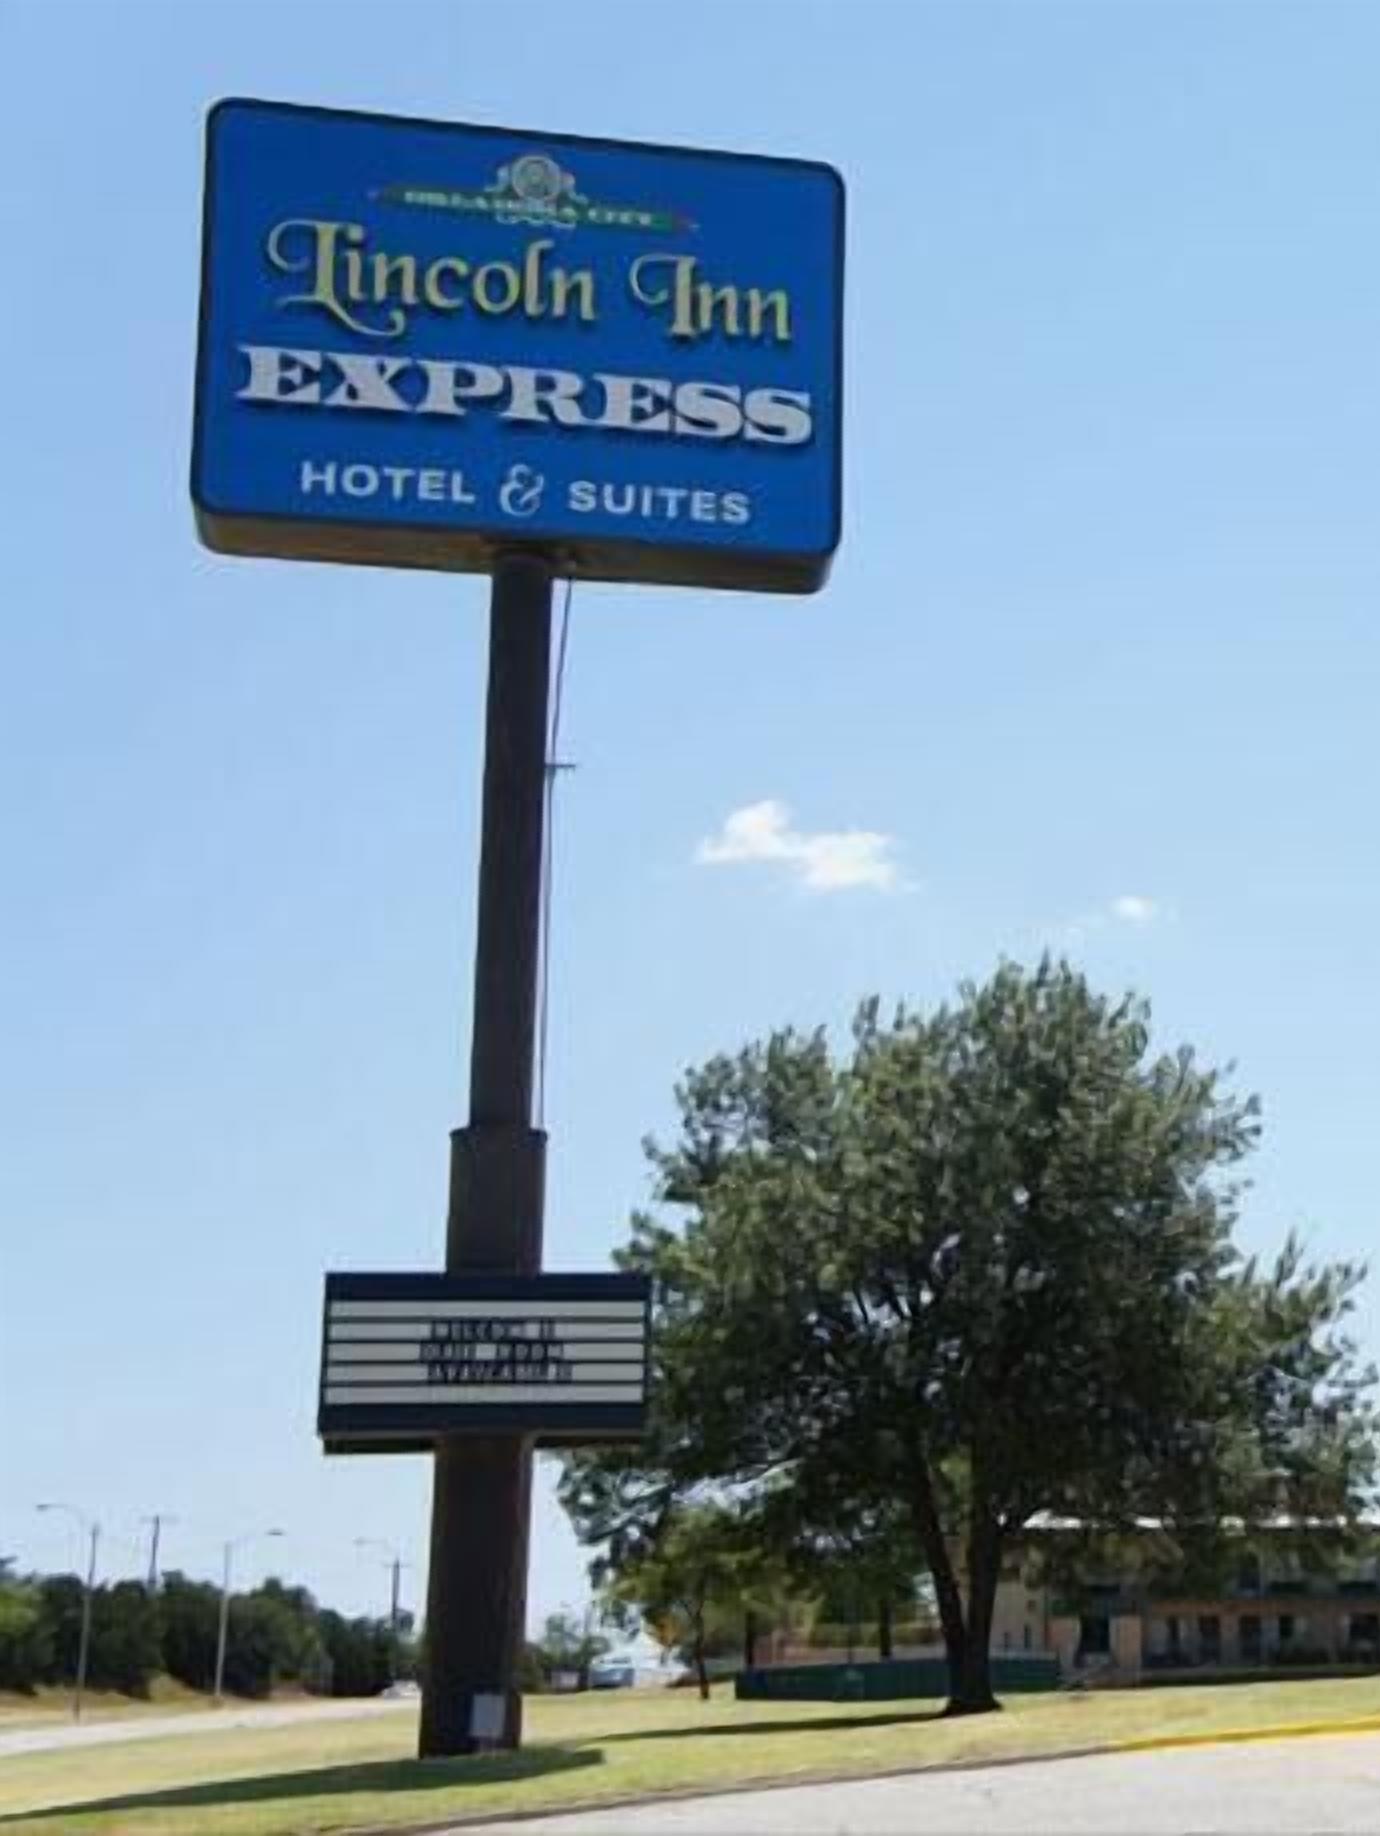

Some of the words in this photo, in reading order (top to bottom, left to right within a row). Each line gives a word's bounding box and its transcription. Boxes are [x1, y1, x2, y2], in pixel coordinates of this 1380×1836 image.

[268, 219, 595, 336] Lincoln
[630, 254, 793, 341] Inn
[236, 346, 814, 444] EXPRESS
[301, 461, 475, 503] HOTEL
[500, 464, 544, 516] &
[568, 480, 751, 525] SUITES
